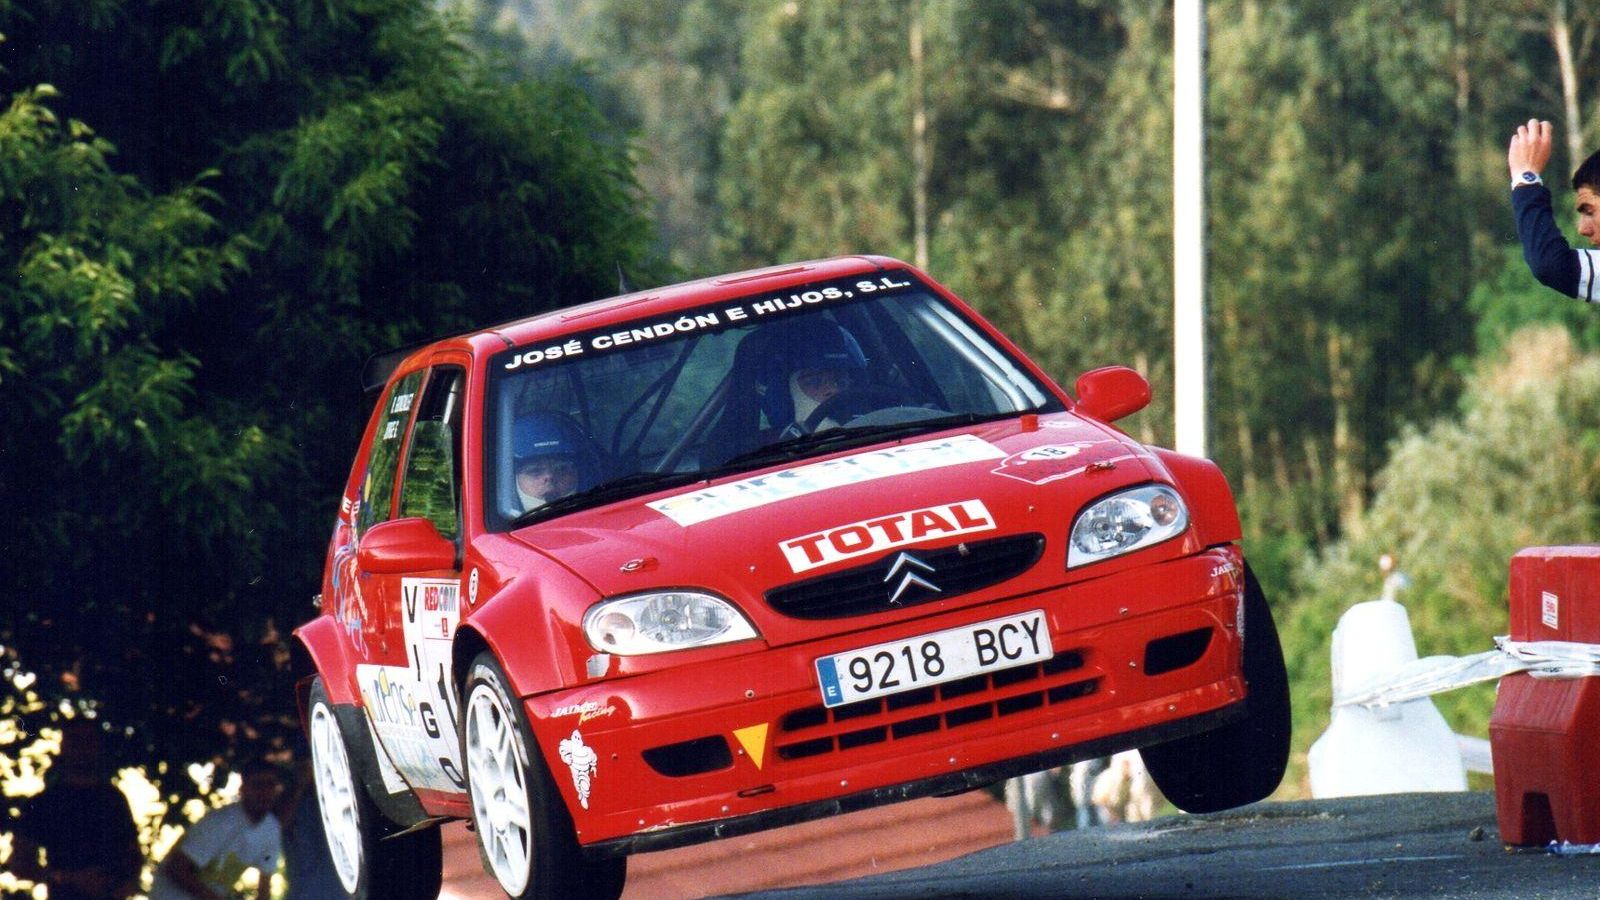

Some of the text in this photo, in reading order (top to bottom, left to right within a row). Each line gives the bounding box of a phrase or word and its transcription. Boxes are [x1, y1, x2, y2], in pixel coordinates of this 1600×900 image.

[504, 276, 912, 370] JOSÉ CENDÓN E HIJOS, S.L.
[1031, 447, 1067, 457] 18
[786, 502, 989, 564] TOTAL
[848, 617, 1040, 693] 9218 BCY
[827, 685, 838, 697] E
